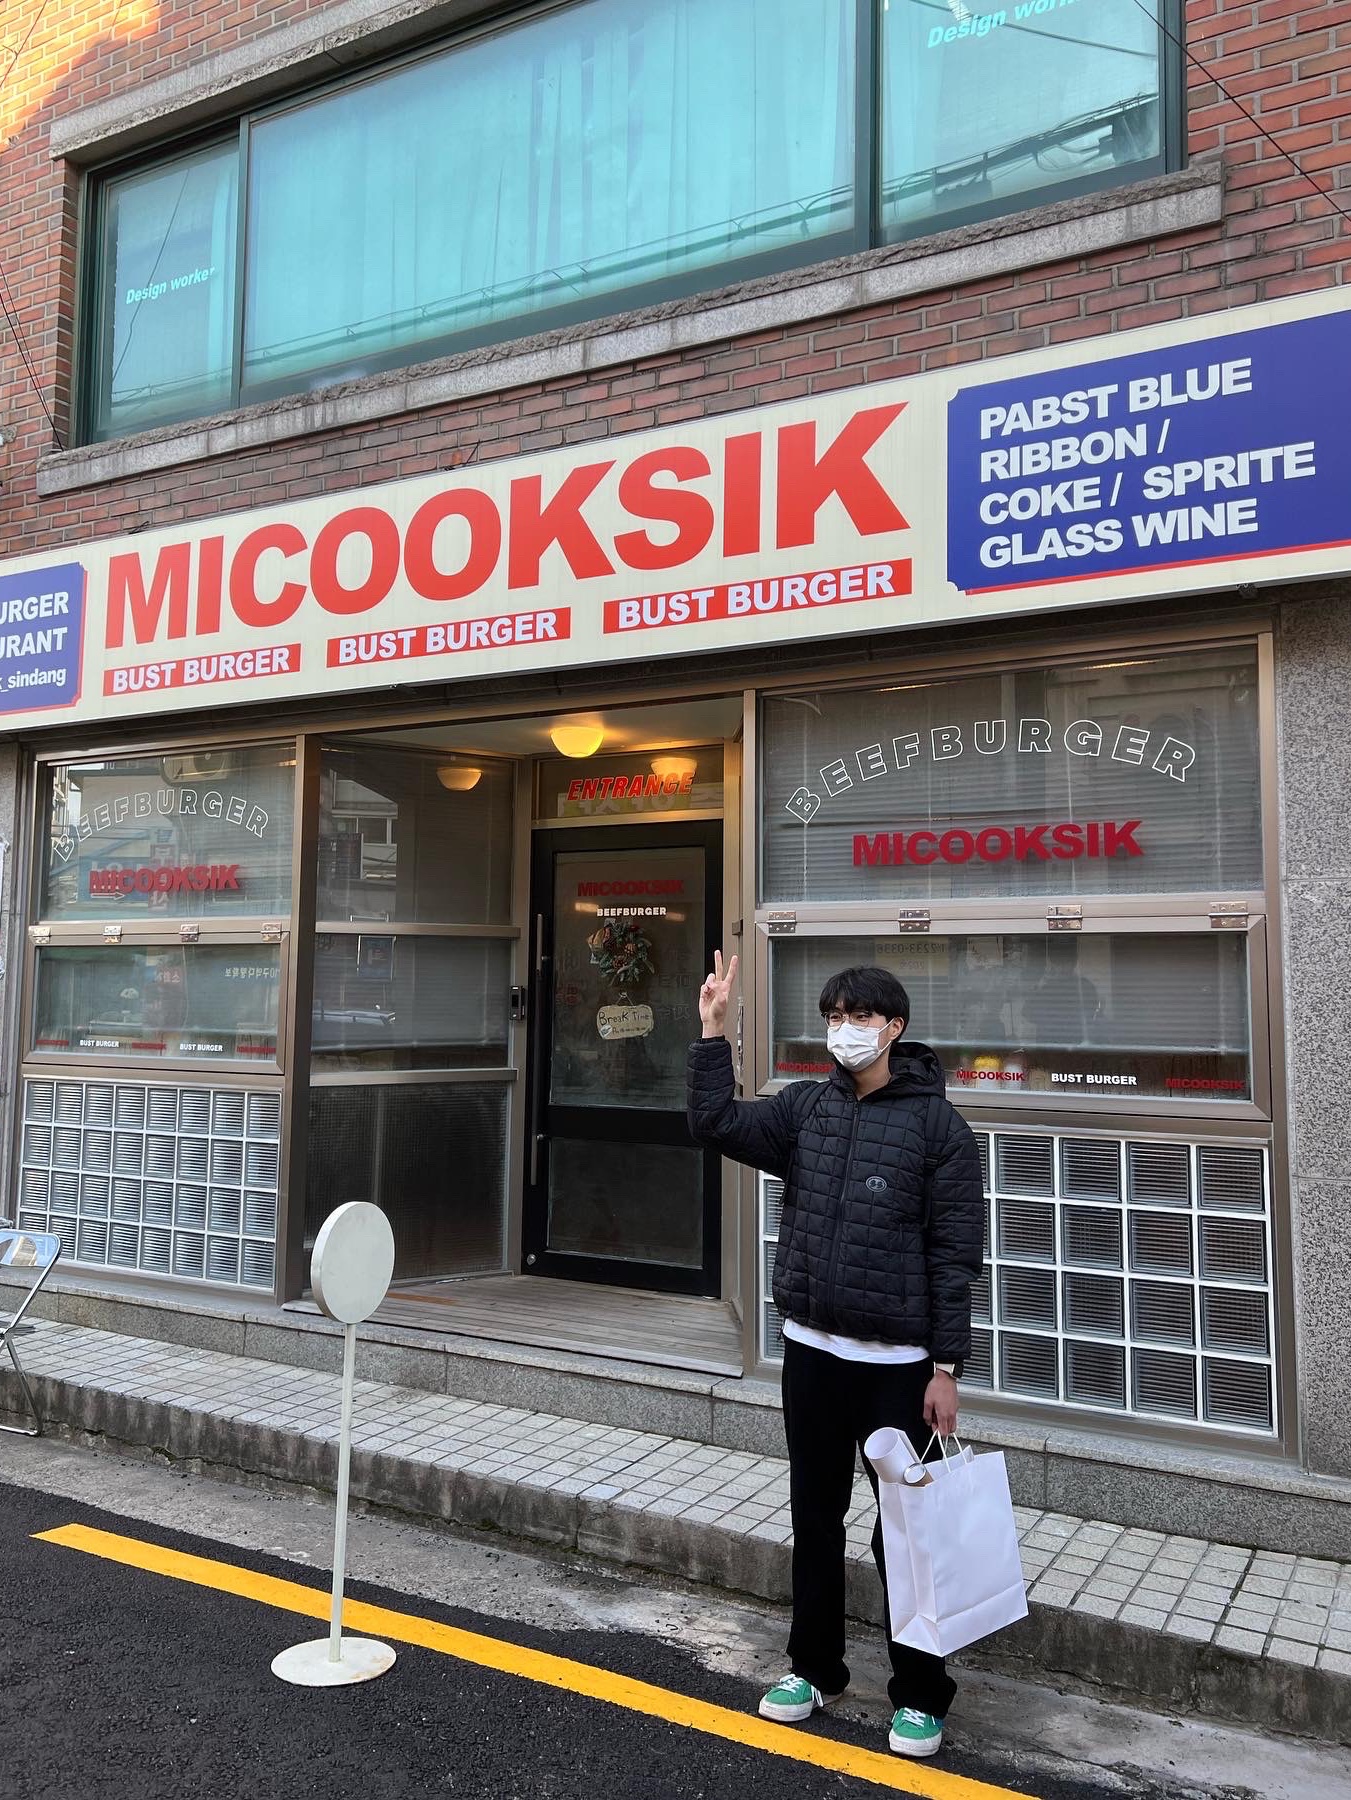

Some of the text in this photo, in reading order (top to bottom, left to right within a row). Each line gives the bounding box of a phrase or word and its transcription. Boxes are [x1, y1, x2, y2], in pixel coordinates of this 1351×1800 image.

[927, 10, 1006, 48] Design
[125, 266, 215, 305] Design worker
[980, 357, 1253, 440] PABST BLUE
[980, 418, 1171, 483] RIBBON /
[979, 441, 1316, 525] COKE / SPRITE
[105, 400, 912, 650] MICOOKSIK
[979, 497, 1259, 568] GLASS WINE
[617, 564, 896, 629] BUST BURGER
[337, 611, 558, 665] BUST BURGER
[112, 647, 291, 694] BUST BURGER
[566, 771, 696, 802] ENTRANCE
[785, 718, 1197, 824] BEEFBURGER
[53, 788, 270, 862] BEEFBURGER
[852, 819, 1144, 867] MICOOKSIK
[88, 864, 241, 894] MICOOKSIK
[596, 906, 668, 918] BEEFBURGER
[598, 1010, 630, 1026] Break
[79, 1039, 96, 1048] BUST
[96, 1040, 120, 1049] BURGER
[179, 1043, 224, 1053] BUST BURGER
[956, 1070, 1026, 1082] MICOOKSIK
[1051, 1072, 1138, 1086] BUST BURGER
[1165, 1077, 1245, 1090] MICOOKSIK
